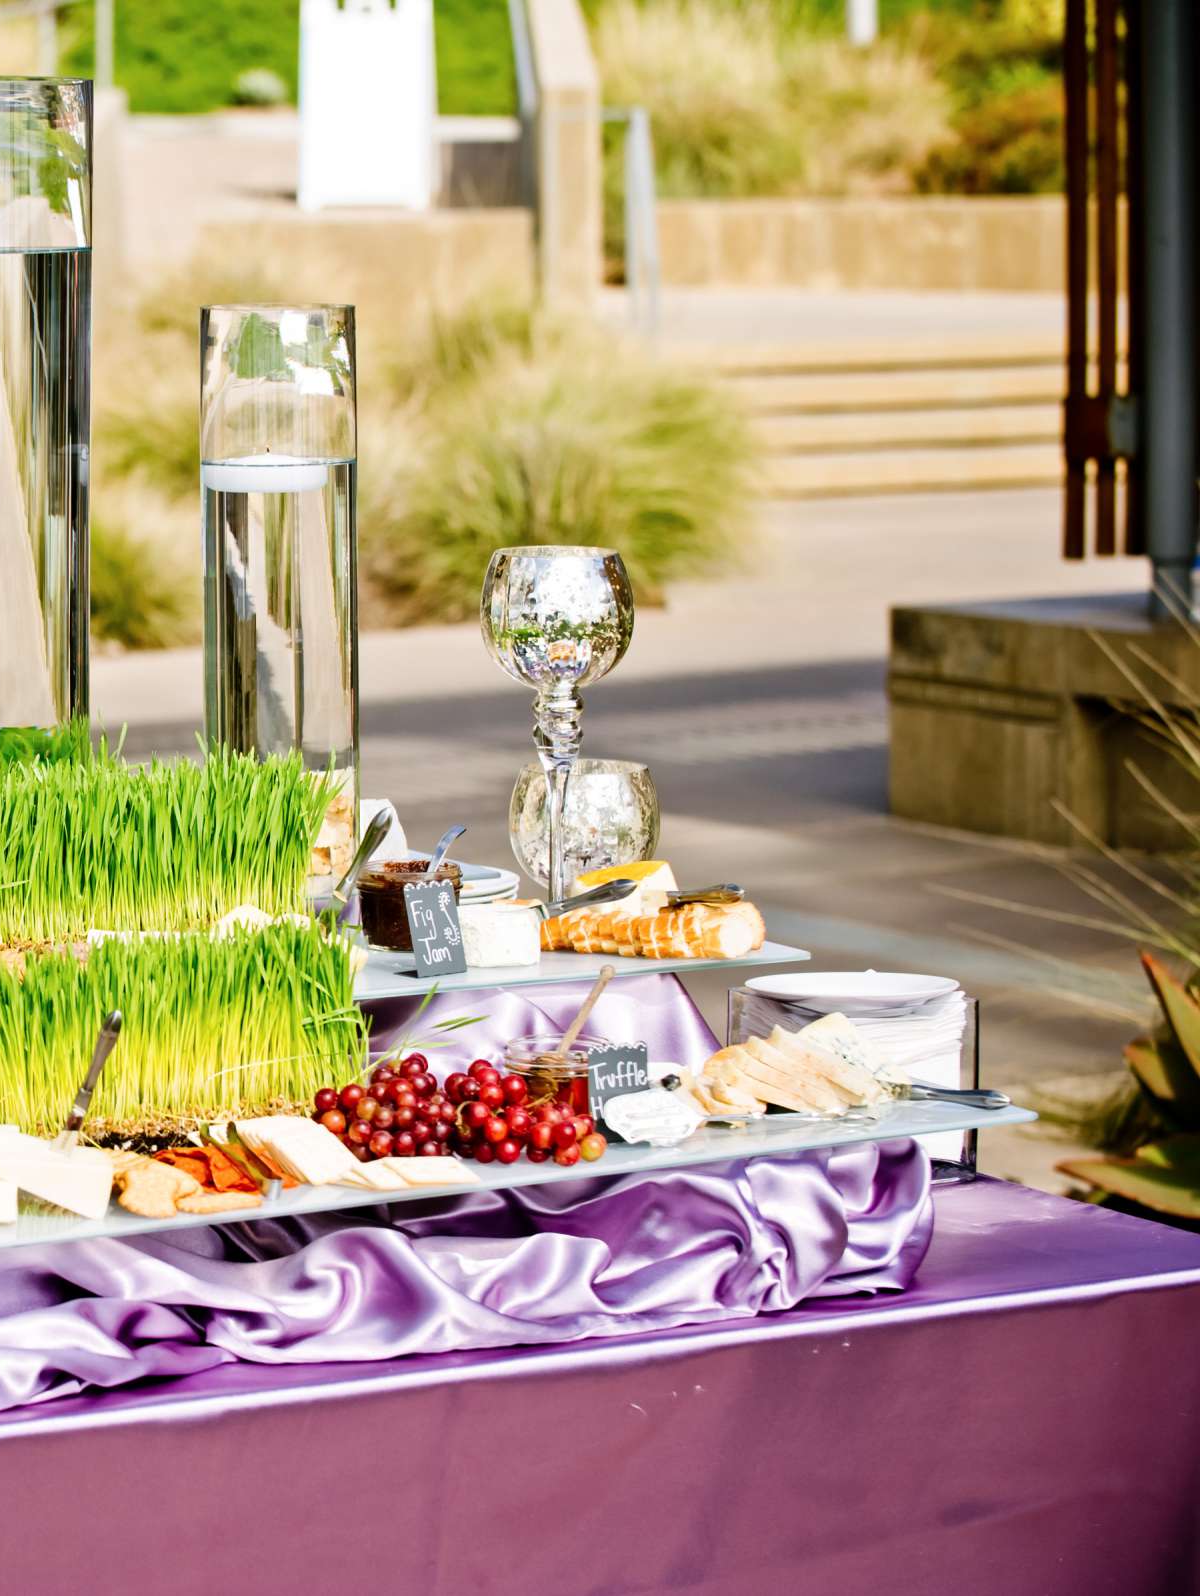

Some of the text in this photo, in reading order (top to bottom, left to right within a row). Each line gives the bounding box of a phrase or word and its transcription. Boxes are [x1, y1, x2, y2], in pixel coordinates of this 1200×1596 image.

[410, 900, 437, 939] Fig
[418, 938, 452, 965] Jam
[589, 1061, 648, 1090] Truffle
